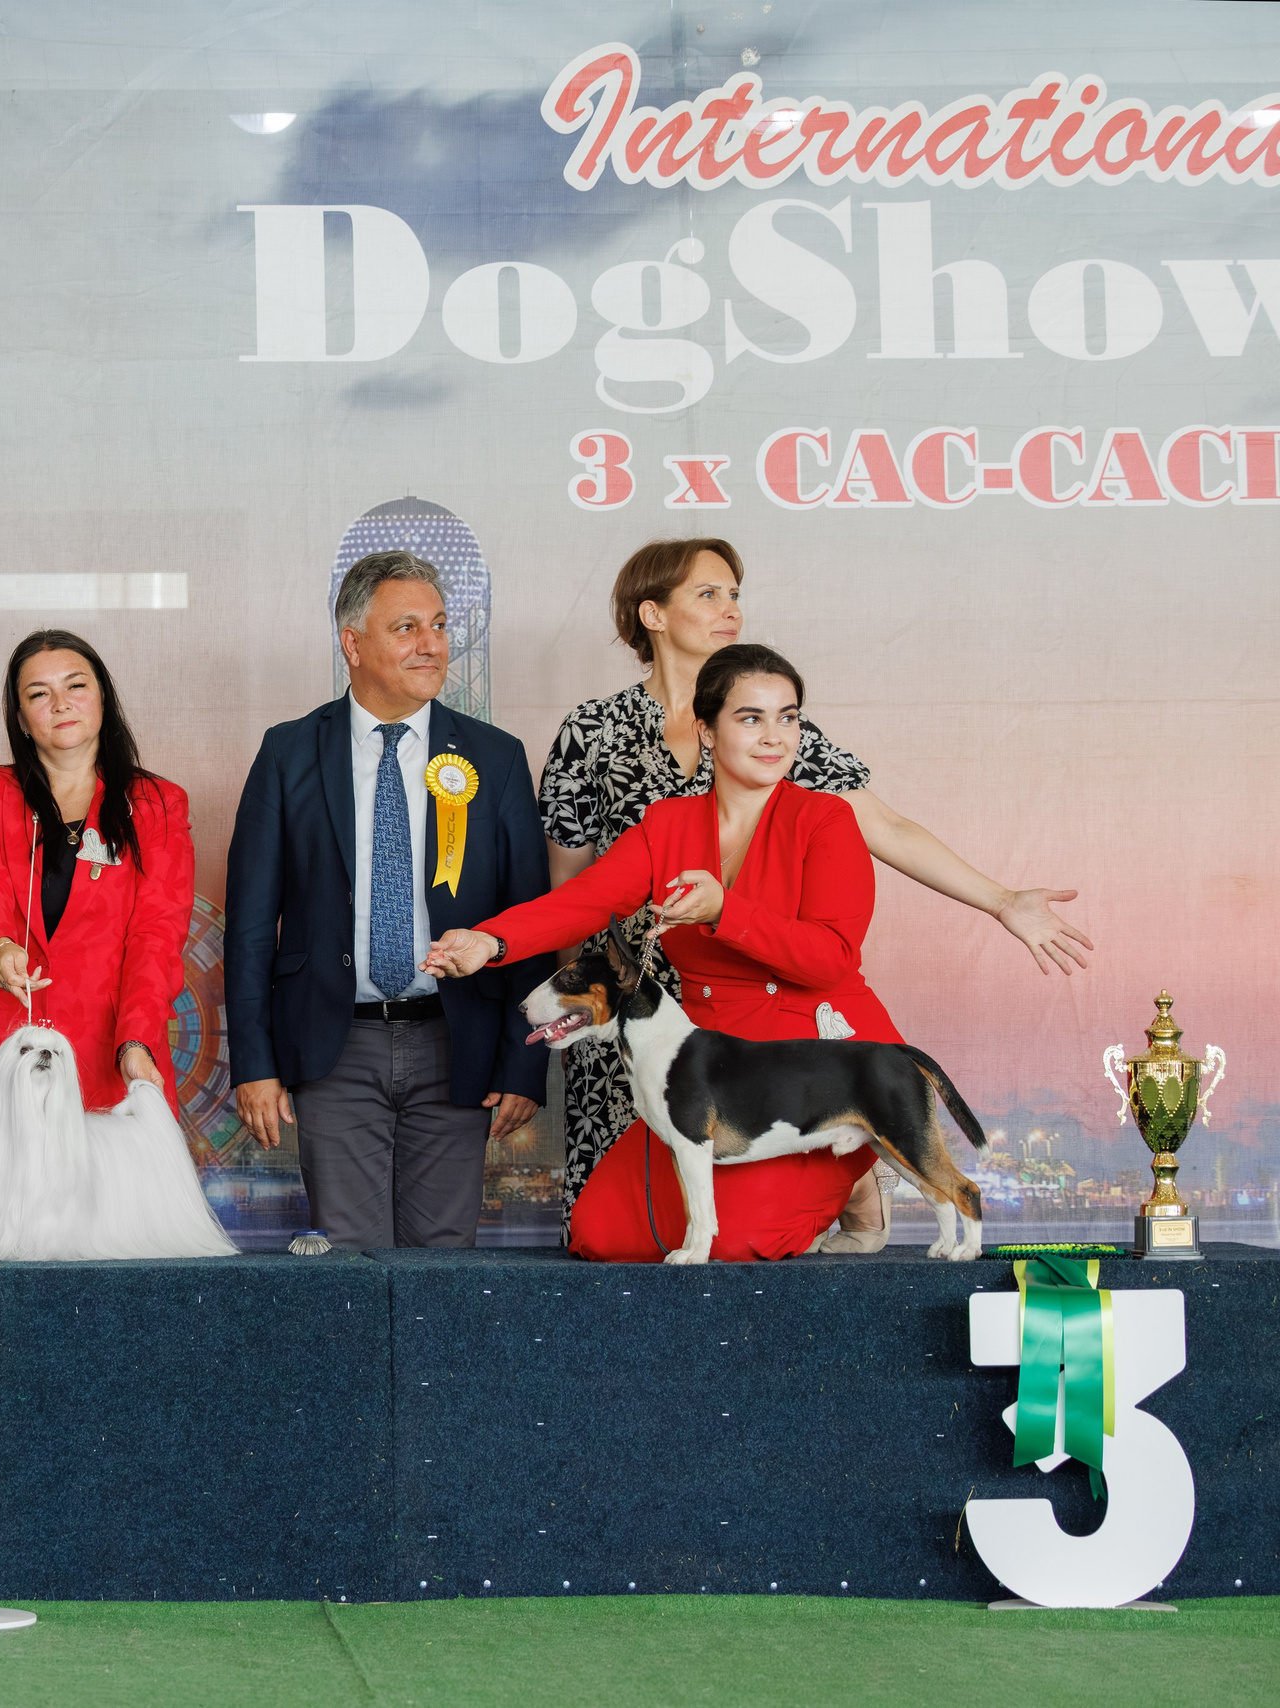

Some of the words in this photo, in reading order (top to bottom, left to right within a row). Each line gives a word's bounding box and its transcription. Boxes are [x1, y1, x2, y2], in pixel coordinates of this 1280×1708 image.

[236, 196, 1280, 414] DogShow
[570, 429, 639, 511] 3
[665, 454, 732, 509] x
[966, 1289, 1195, 1608] 3
